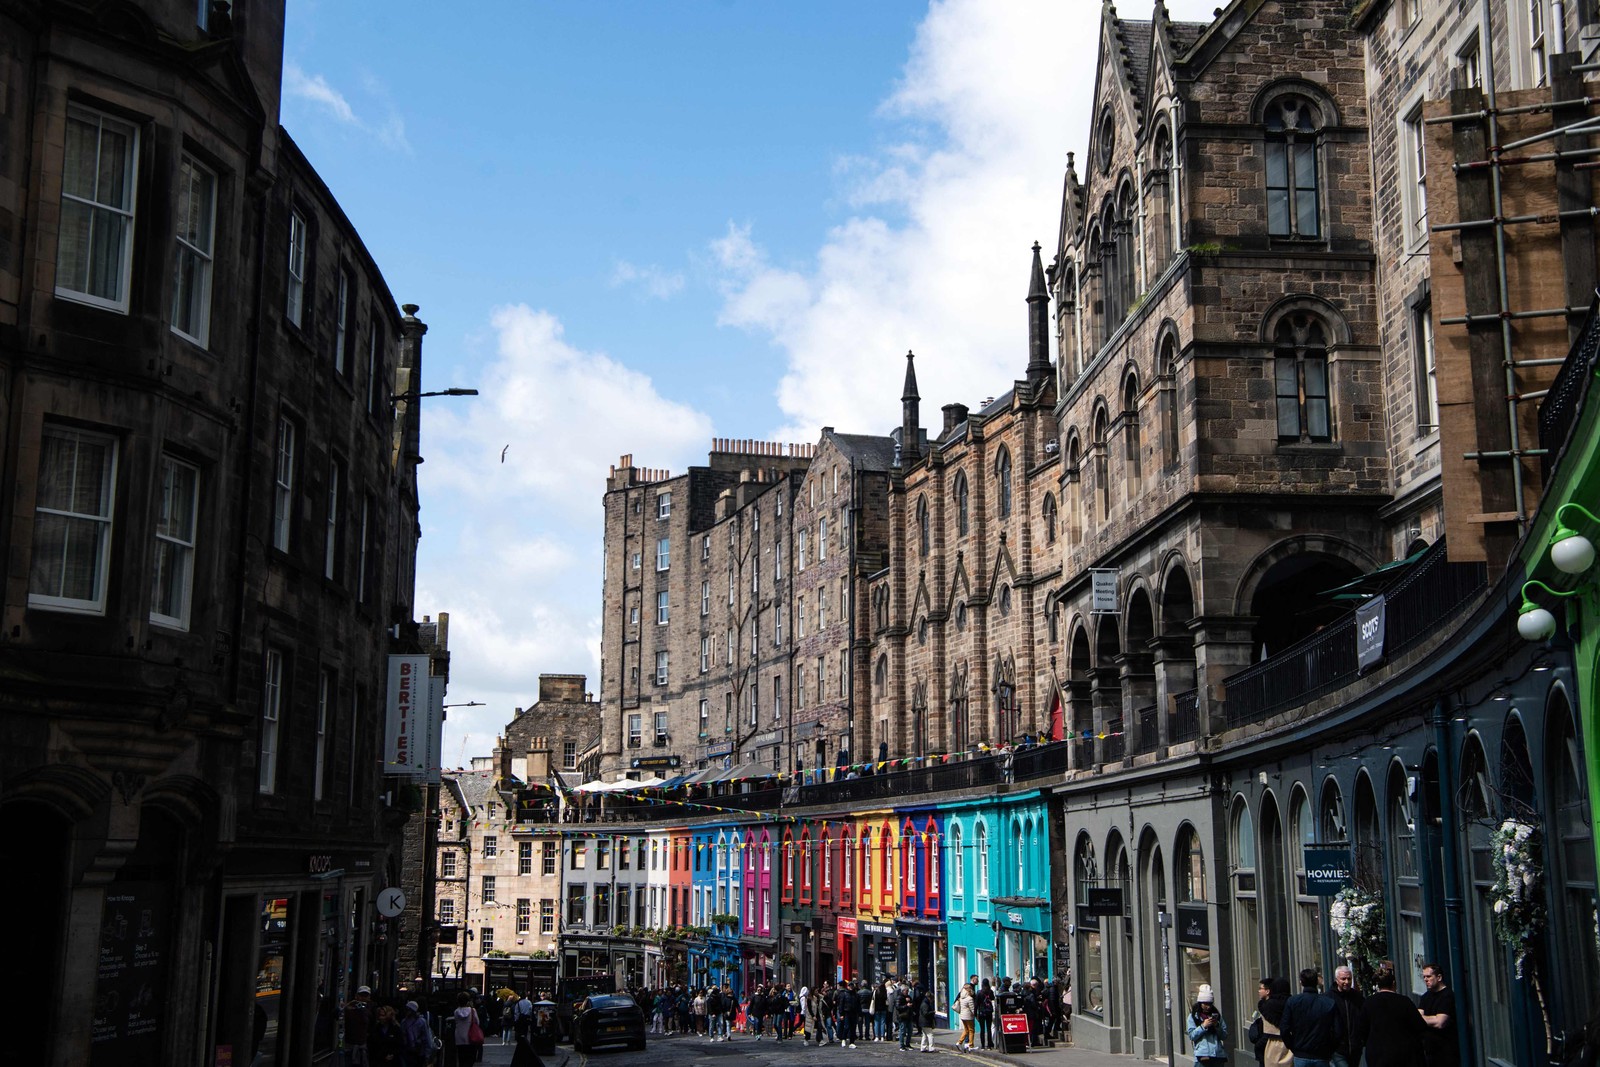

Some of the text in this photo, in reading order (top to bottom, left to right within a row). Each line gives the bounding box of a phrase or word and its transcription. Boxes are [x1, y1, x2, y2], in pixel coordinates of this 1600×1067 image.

[1362, 615, 1379, 640] SCOTS
[397, 663, 411, 765] BERTIES
[309, 855, 331, 872] KNOOPS
[390, 895, 402, 910] K
[871, 924, 883, 933] WHISKY
[883, 926, 892, 934] SHOP
